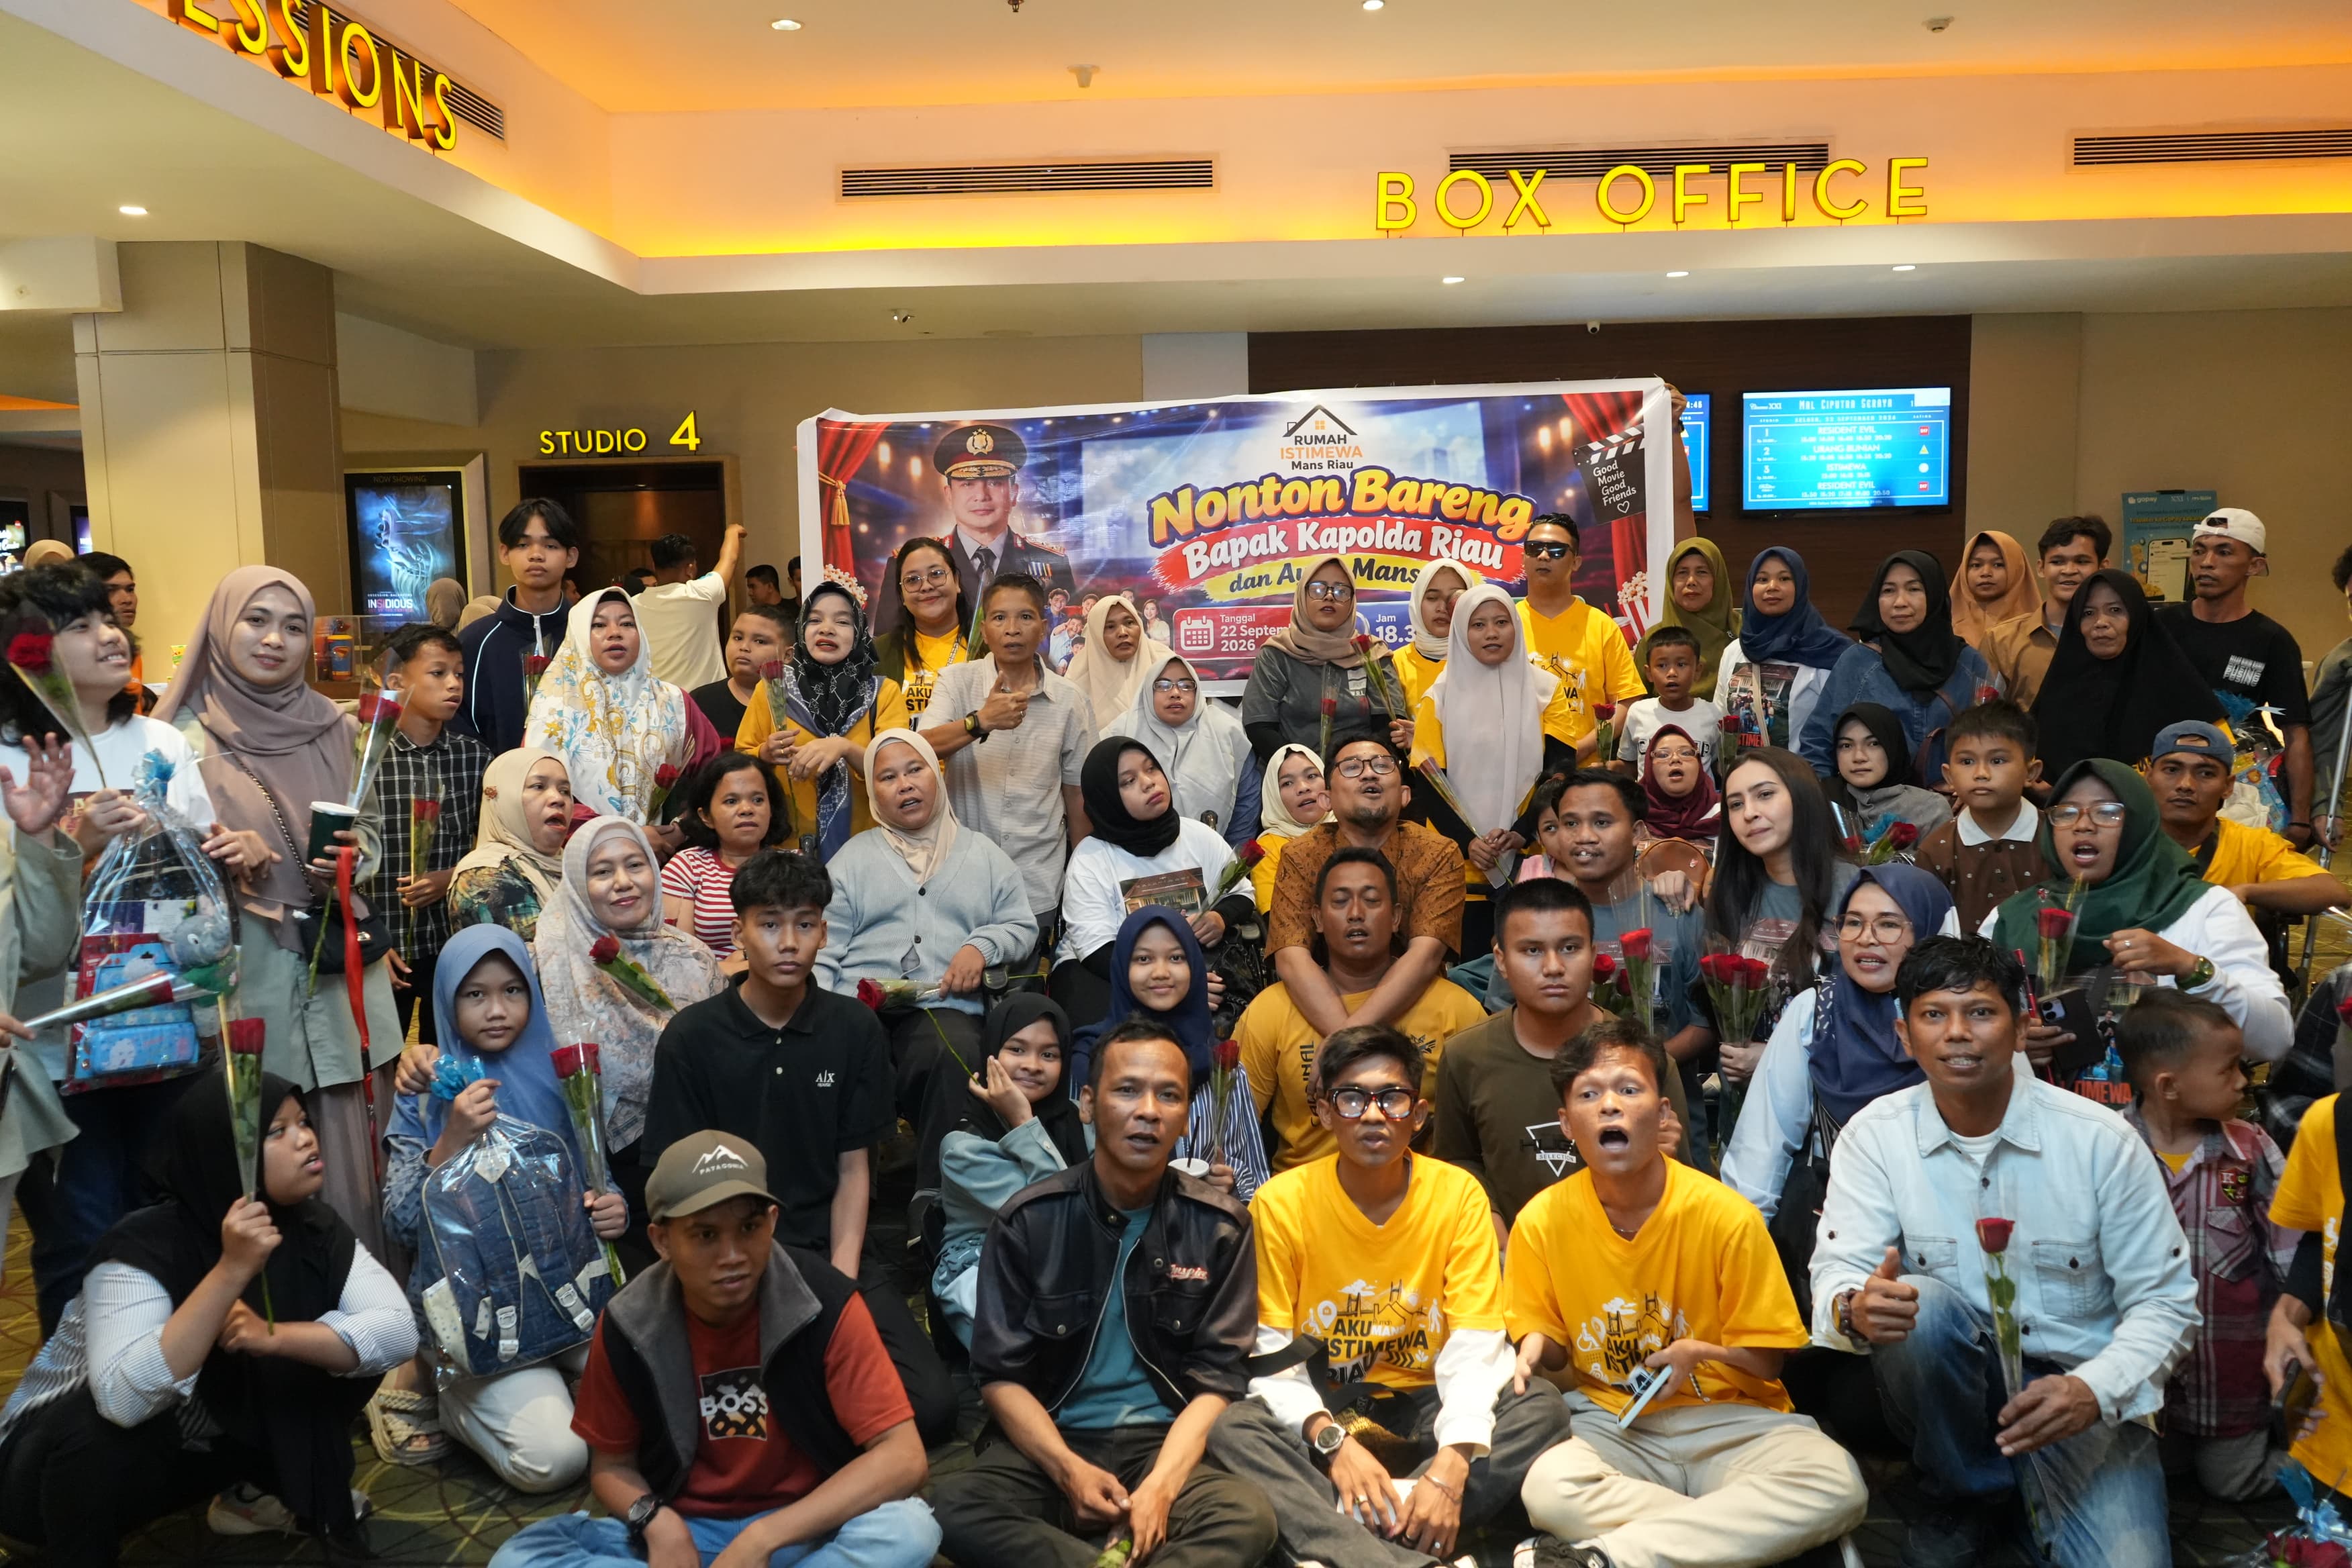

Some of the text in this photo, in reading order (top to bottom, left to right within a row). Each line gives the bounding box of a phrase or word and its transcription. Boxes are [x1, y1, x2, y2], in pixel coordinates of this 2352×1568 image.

[1377, 157, 1928, 230] BOX OFFICE
[1821, 399, 1855, 409] CIPUTRA
[540, 410, 701, 454] STUDIO 4
[1818, 426, 1877, 434] RESIDENT EVIL
[1294, 434, 1346, 445] RUMAH
[1280, 446, 1363, 459] ISTIMEWA
[1763, 447, 1769, 455] 2
[1291, 459, 1353, 470] Mans Riau
[1593, 460, 1618, 477] Good
[1826, 463, 1867, 471] ISTIMEWA
[393, 475, 427, 483] SHOWING
[1598, 471, 1625, 487] Movie
[1818, 481, 1875, 490] RESIDENT EVIL
[1602, 479, 1626, 495] Good
[1602, 486, 1636, 506] Friends
[1151, 468, 1533, 542] Nonton Bareng
[1183, 524, 1288, 579] Bapak
[1297, 520, 1422, 554] Kapolda
[1430, 525, 1503, 569] Riau
[1353, 557, 1419, 583] Mans
[1229, 572, 1273, 593] dan
[368, 598, 413, 609] INSIDIOUS
[1220, 614, 1255, 624] Tanggal
[1375, 614, 1397, 624] Jam
[1220, 625, 1289, 639] 22 Septem
[1376, 626, 1416, 643] 18.3
[1220, 640, 1256, 651] 2026
[907, 687, 932, 698] AKU
[1538, 1153, 1575, 1163] SELECTION
[1333, 1318, 1372, 1336] AKU
[699, 1391, 769, 1417] BOSS
